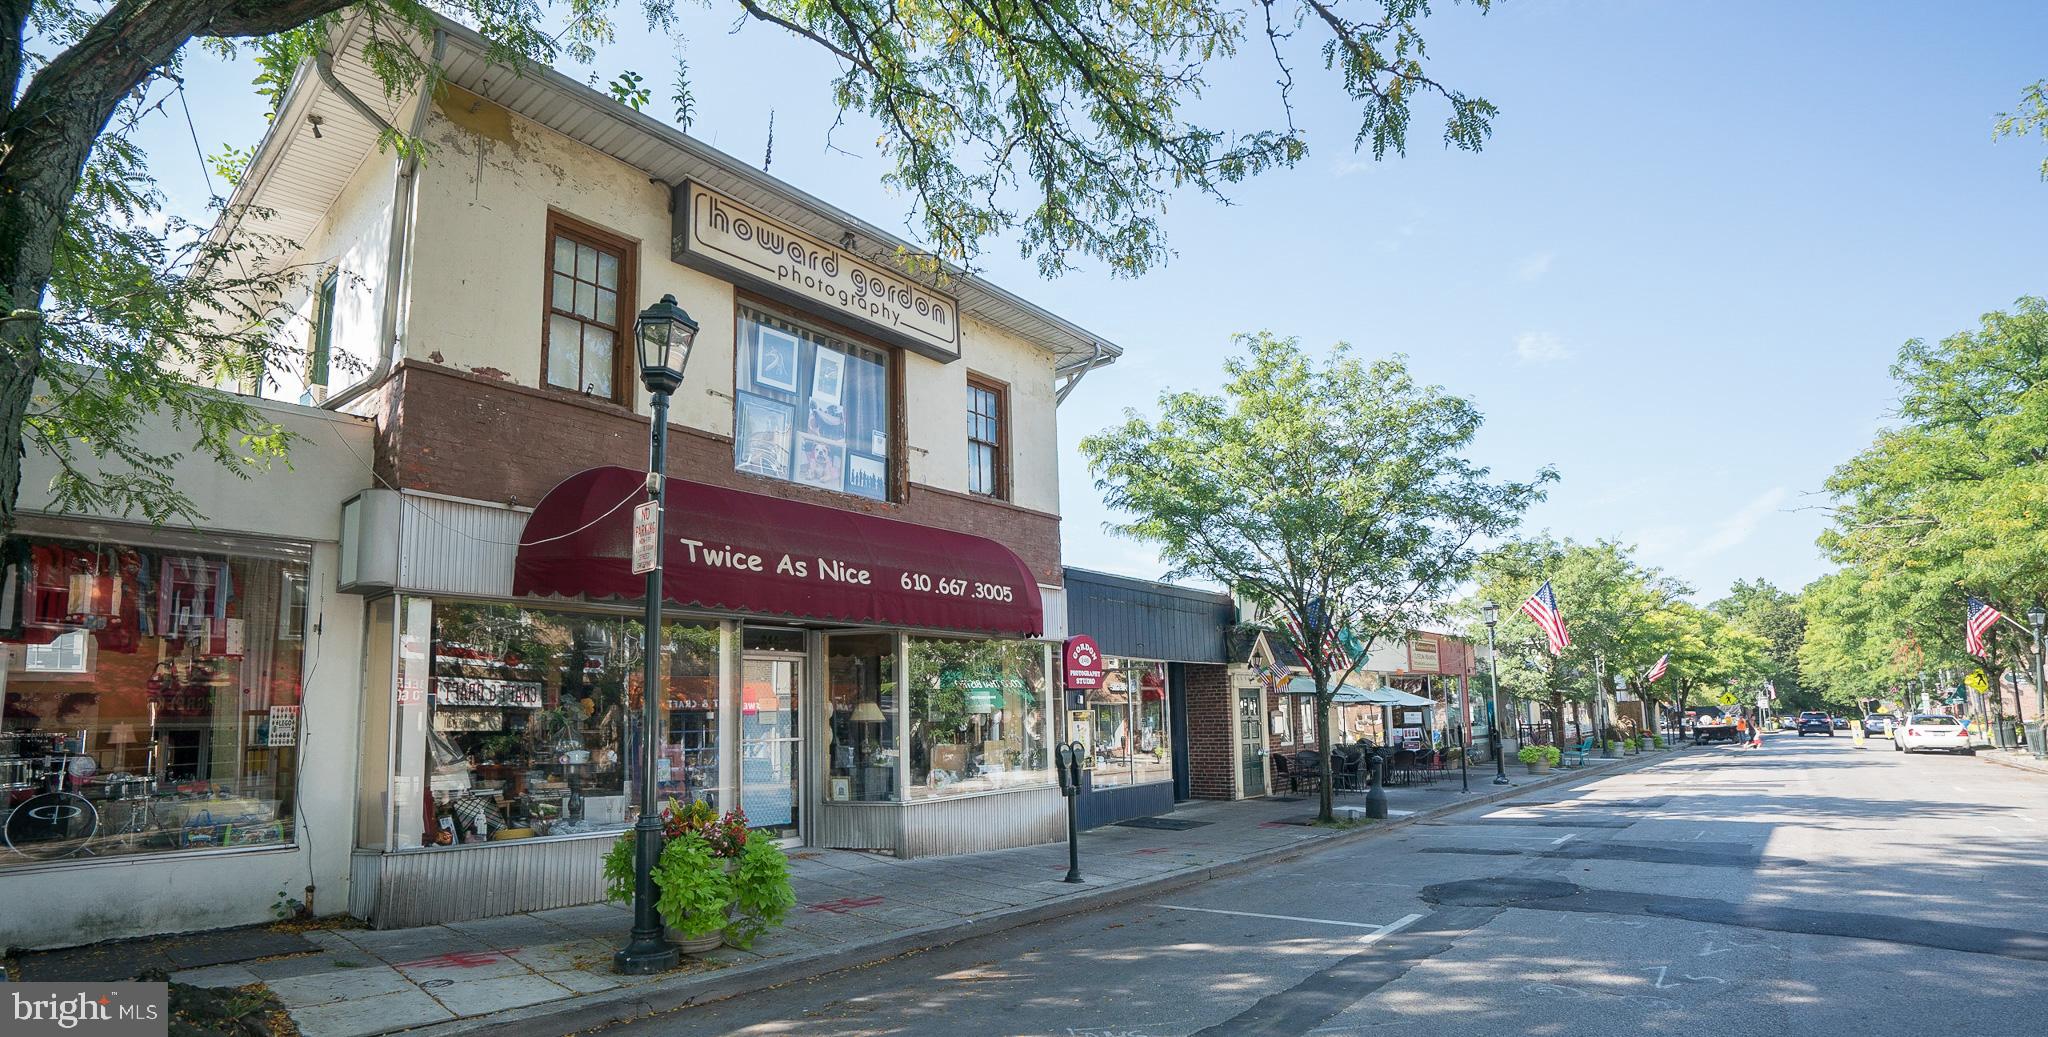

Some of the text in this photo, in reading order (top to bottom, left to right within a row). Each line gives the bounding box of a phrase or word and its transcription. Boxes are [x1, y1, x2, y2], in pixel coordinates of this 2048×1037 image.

[708, 195, 946, 325] howard gordon
[777, 264, 901, 327] photography
[680, 538, 763, 572] Twice
[776, 554, 808, 577] As
[817, 557, 871, 585] Nice
[1072, 643, 1097, 661] GORDON
[1070, 669, 1101, 678] PHOTOGRAPHY
[1076, 677, 1096, 685] STUDIO
